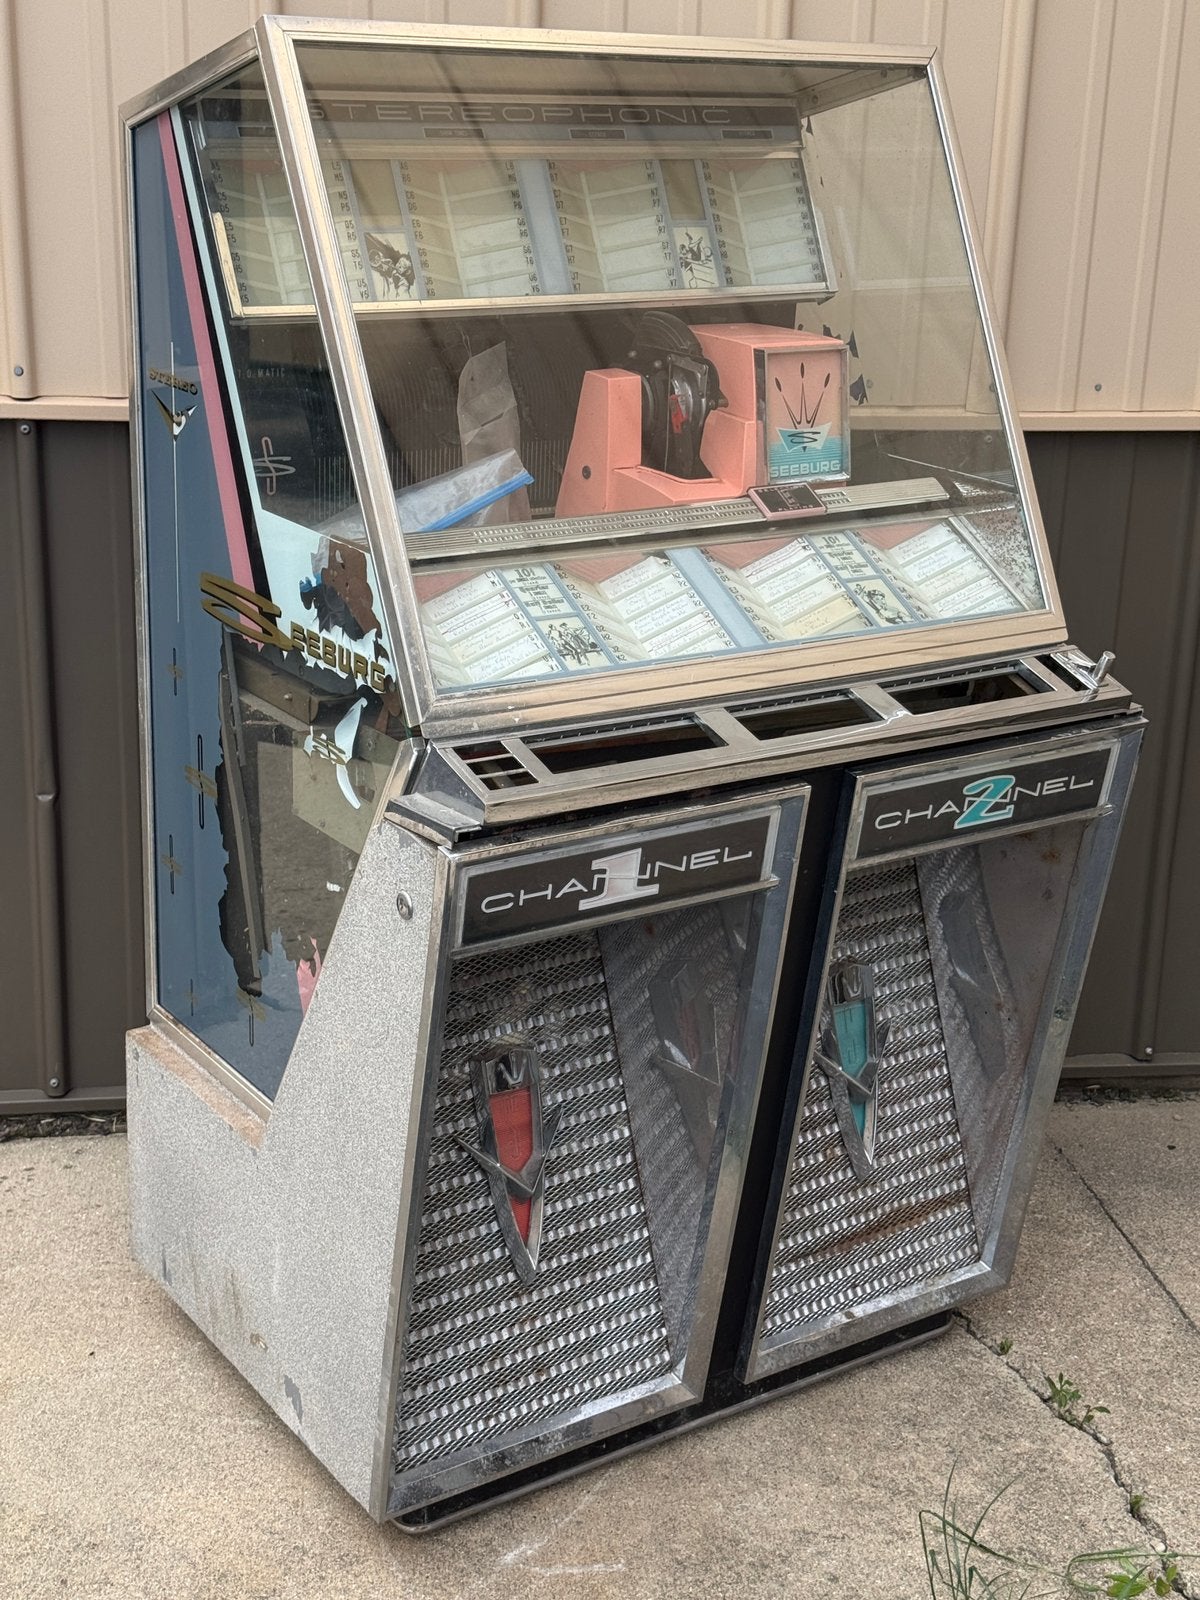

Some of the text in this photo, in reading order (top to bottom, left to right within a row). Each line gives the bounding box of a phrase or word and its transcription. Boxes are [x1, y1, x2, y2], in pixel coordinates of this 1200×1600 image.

[310, 103, 730, 123] STEREOPHONIC
[332, 161, 342, 170] L5
[341, 202, 350, 212] P5
[354, 260, 363, 270] T5
[149, 368, 198, 395] STEREO
[771, 460, 841, 479] SEEBURG
[484, 571, 496, 579] L1
[200, 572, 387, 694] SEEBURG
[875, 775, 1094, 830] CHANNEL
[954, 774, 1015, 829] 2
[481, 847, 752, 914] CHANNEL
[578, 847, 660, 912] 1
